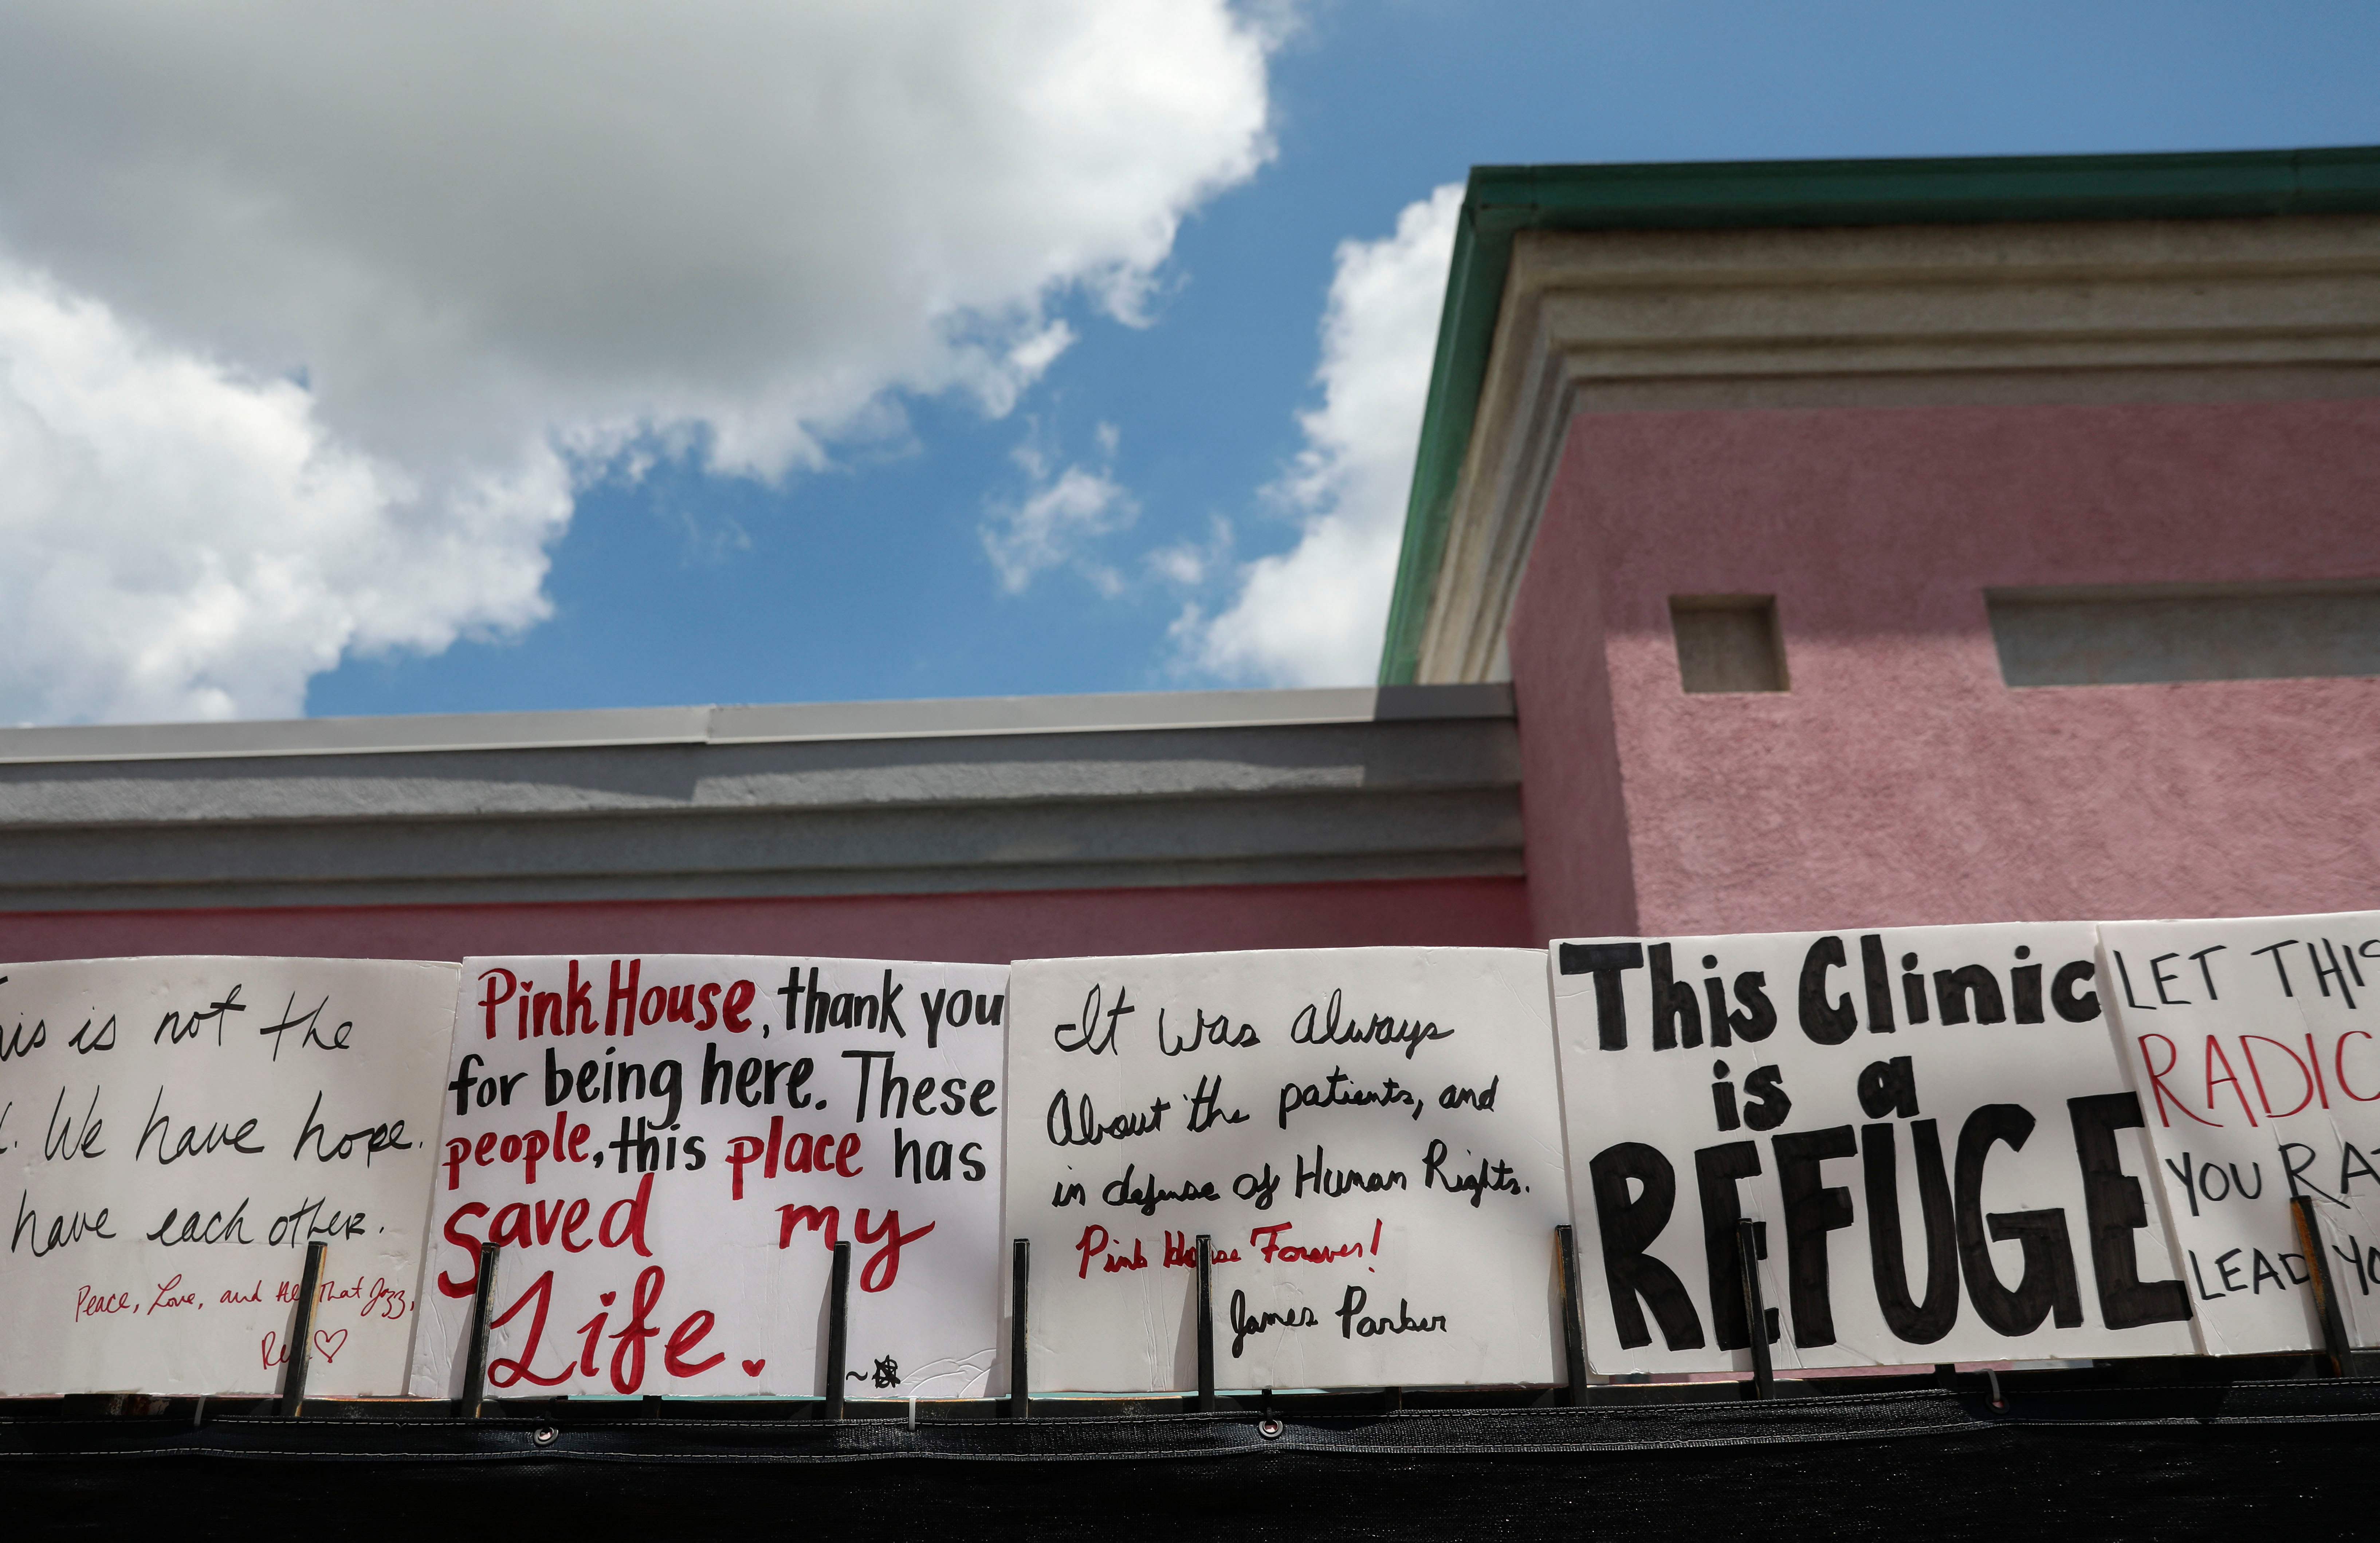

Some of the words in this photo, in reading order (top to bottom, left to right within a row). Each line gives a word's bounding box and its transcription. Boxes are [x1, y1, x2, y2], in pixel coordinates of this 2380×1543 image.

[478, 960, 600, 1040] Pink
[605, 959, 770, 1040] House,
[778, 967, 906, 1039] thank
[920, 988, 1005, 1049] you
[1559, 942, 1778, 1051] This
[1799, 933, 2102, 1045] Clinic
[2113, 945, 2227, 1009] LET
[0, 976, 46, 1062] is
[68, 1006, 115, 1054] is
[154, 984, 246, 1057] not
[260, 991, 353, 1062] the
[1054, 983, 1135, 1056] It
[448, 1053, 528, 1116] for
[545, 1047, 682, 1130] being
[700, 1042, 827, 1111] here.
[841, 1051, 997, 1123] These
[1183, 1074, 1250, 1133] the
[1279, 1065, 1424, 1130] patients,
[1439, 1075, 1499, 1112] and
[1712, 1059, 1792, 1132] is
[1858, 1056, 1920, 1119] a
[2138, 1031, 2380, 1127] RADIC
[45, 1085, 106, 1161] We
[136, 1085, 265, 1165] have
[294, 1090, 423, 1168] hope.
[441, 1111, 603, 1191] people,
[608, 1116, 706, 1173] this
[725, 1115, 863, 1201] place
[894, 1127, 986, 1184] has
[1051, 1165, 1085, 1208] in
[1102, 1163, 1221, 1216] defense
[1233, 1164, 1280, 1210] of
[1295, 1145, 1407, 1199] Human
[1422, 1139, 1530, 1208] Rights.
[2165, 1152, 2262, 1217] YOU
[2278, 1141, 2380, 1210] RA
[11, 1189, 117, 1257] have
[146, 1197, 255, 1244] each
[775, 1204, 936, 1293] my
[1076, 1224, 1148, 1279] Pink
[1163, 1230, 1242, 1268] Hose
[1250, 1218, 1383, 1273] Forever!
[1590, 1091, 2193, 1352] REFUGE
[75, 1286, 138, 1322] Peace,
[147, 1274, 204, 1315] Love,
[220, 1280, 262, 1303] and
[276, 1281, 299, 1303] Al
[360, 1278, 415, 1319] Jazz,
[2189, 1248, 2310, 1301] LEAD
[1230, 1289, 1319, 1358] James
